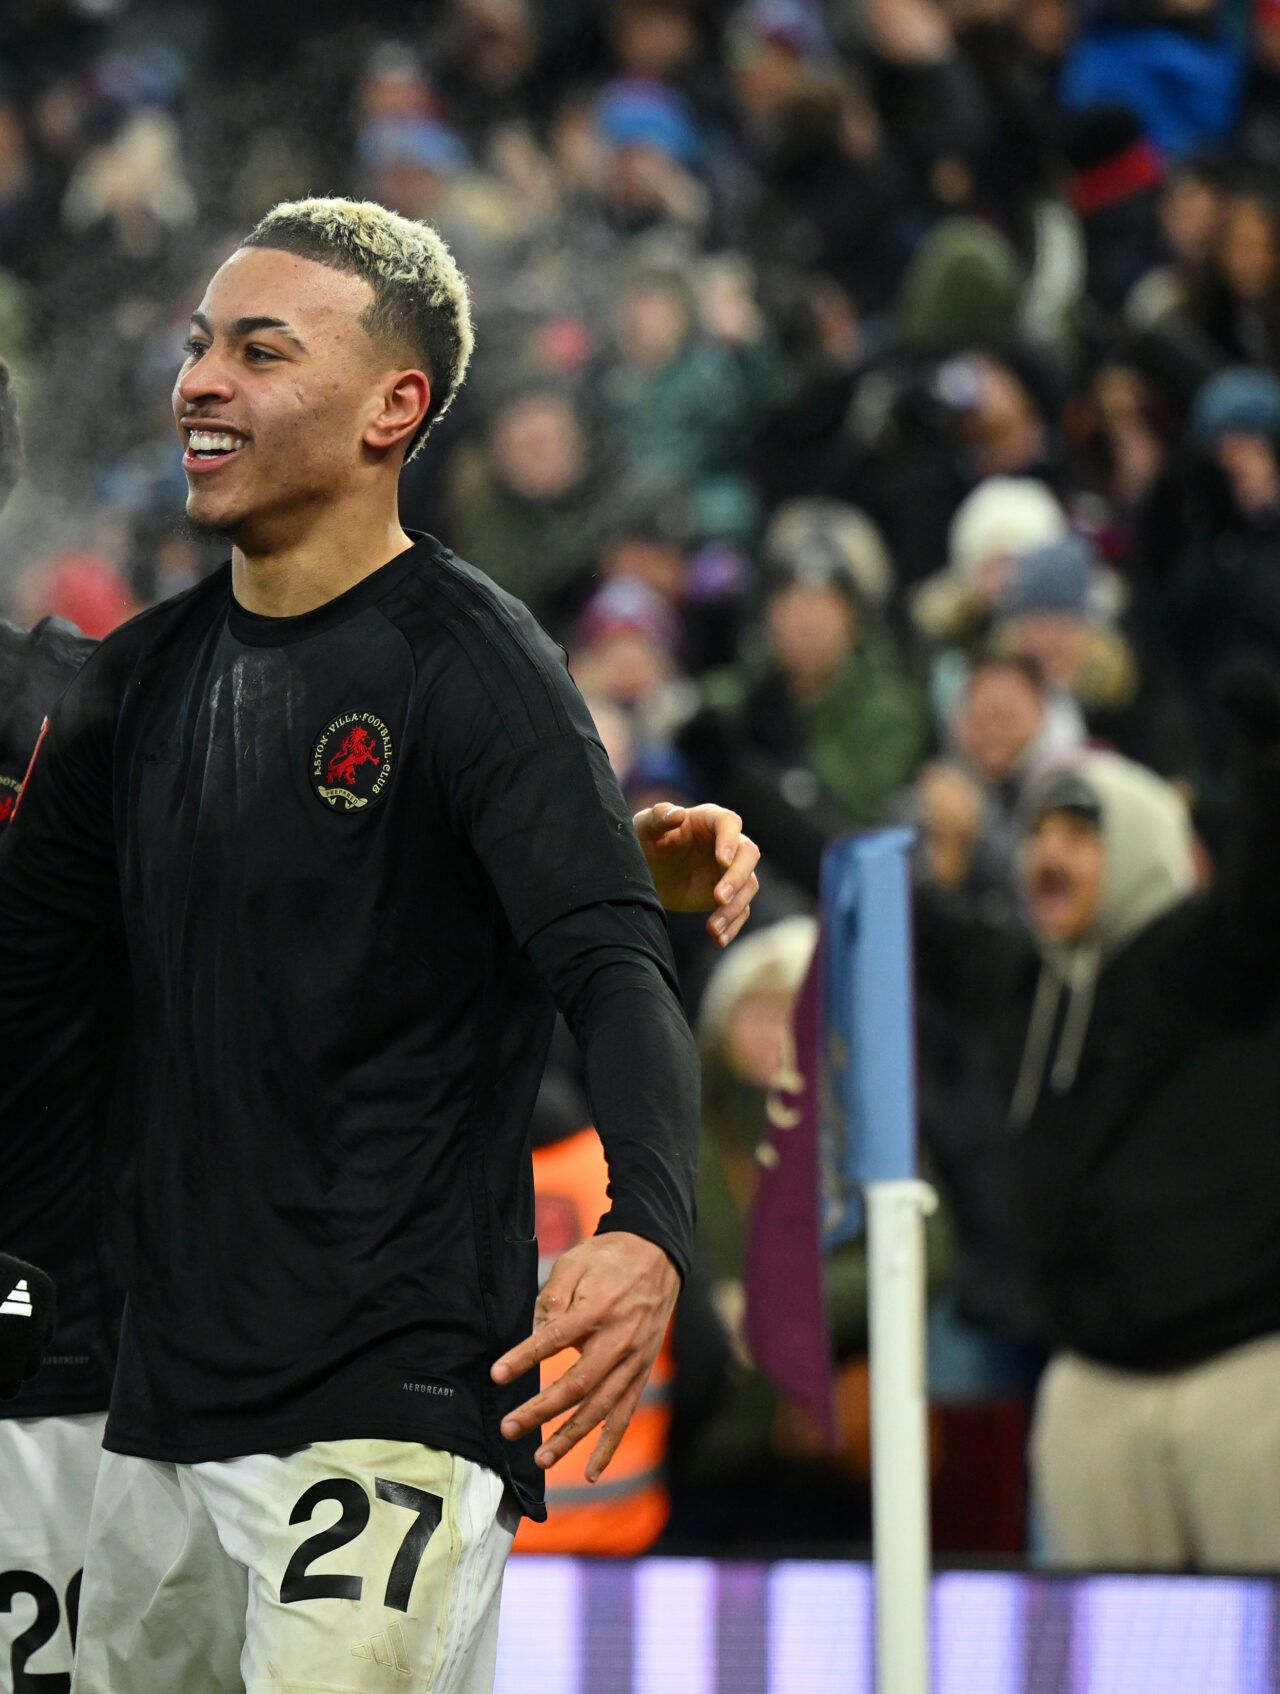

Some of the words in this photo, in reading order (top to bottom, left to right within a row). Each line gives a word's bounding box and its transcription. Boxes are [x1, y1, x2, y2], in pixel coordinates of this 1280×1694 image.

[328, 713, 358, 733] VILLA
[361, 712, 393, 759] FOOTBALL
[313, 735, 329, 776] ASTON
[372, 763, 391, 794] CLUB
[402, 1382, 454, 1397] AEROREADY
[279, 1476, 444, 1613] 27
